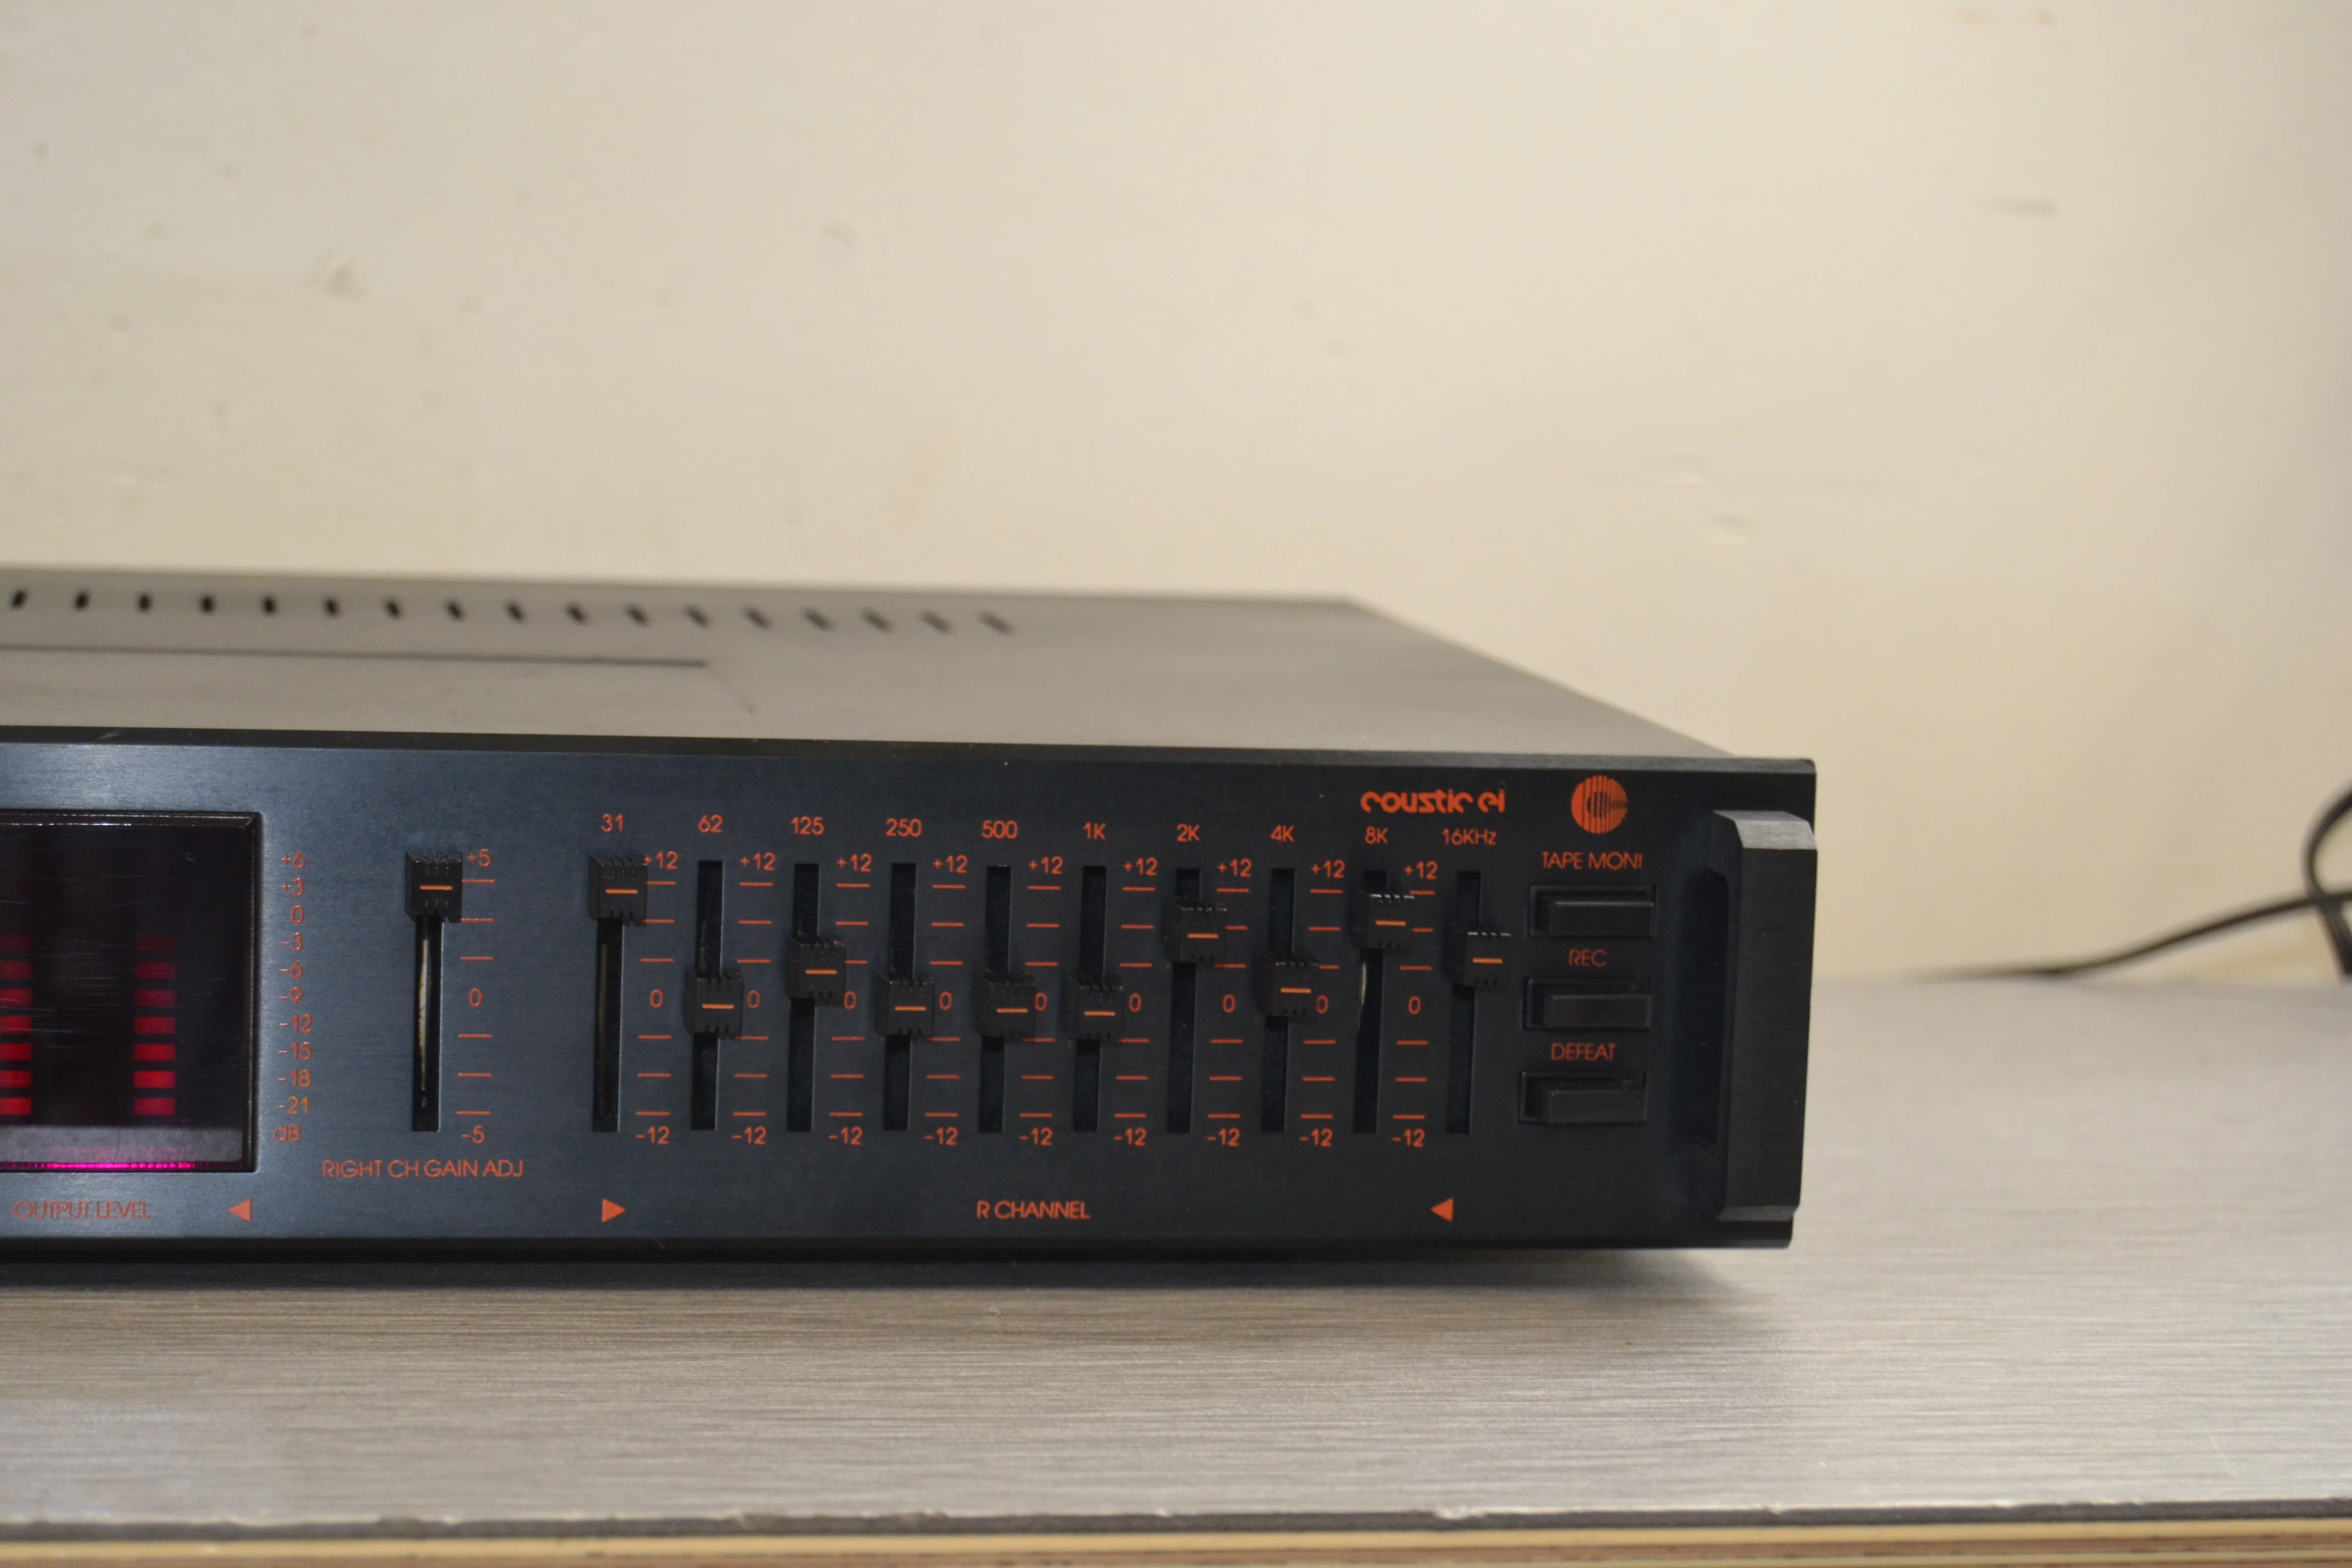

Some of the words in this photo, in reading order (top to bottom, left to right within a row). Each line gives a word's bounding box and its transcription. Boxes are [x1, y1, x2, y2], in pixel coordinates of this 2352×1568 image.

[601, 814, 624, 833] 31
[698, 814, 723, 834] 62
[791, 816, 825, 836] 125
[886, 818, 922, 837] 250
[982, 820, 1018, 839] 500
[1085, 822, 1106, 840] 1K
[1177, 824, 1199, 842] 2K
[1270, 825, 1294, 842] 4K
[1365, 826, 1388, 845] 8K
[1442, 828, 1497, 846] 16KHz
[283, 851, 306, 870] +6
[469, 848, 492, 868] +5
[644, 850, 679, 870] +12
[741, 852, 776, 871] +12
[838, 853, 873, 873] +12
[934, 854, 968, 874] +12
[1029, 855, 1064, 875] +12
[1123, 856, 1158, 876] +12
[1542, 851, 1582, 870] TAPE
[1218, 858, 1253, 878] +12
[1311, 859, 1346, 879] +12
[1404, 860, 1438, 880] +12
[282, 878, 305, 897] +3
[290, 905, 305, 924] 0
[280, 933, 304, 951] -3
[1569, 948, 1606, 967] REC
[280, 961, 304, 978] -6
[280, 987, 304, 1005] -9
[469, 988, 483, 1007] 0
[650, 989, 664, 1009] 0
[747, 990, 761, 1009] 0
[843, 991, 857, 1010] 0
[939, 992, 952, 1010] 0
[1034, 992, 1047, 1011] 0
[1129, 993, 1142, 1012] 0
[1222, 994, 1236, 1013] 0
[1316, 995, 1329, 1014] 0
[1408, 996, 1422, 1015] 0
[279, 1014, 313, 1034] -12
[279, 1042, 313, 1061] -15
[1551, 1042, 1615, 1061] DEFEAT
[279, 1069, 312, 1088] -18
[277, 1096, 309, 1115] -21
[274, 1124, 301, 1142] dB
[462, 1125, 486, 1144] -5
[636, 1125, 670, 1145] -12
[733, 1125, 767, 1145] -12
[829, 1126, 864, 1146] -12
[925, 1126, 959, 1146] -12
[1020, 1126, 1054, 1146] -12
[1114, 1127, 1147, 1147] -12
[1208, 1128, 1241, 1147] -12
[1300, 1128, 1333, 1147] -12
[1392, 1128, 1426, 1148] -12
[323, 1160, 383, 1179] RIGHT
[387, 1160, 420, 1179] CH
[424, 1160, 479, 1178] GAIN
[482, 1159, 524, 1178] ADJ
[13, 1200, 90, 1219] OUTPUT
[95, 1200, 149, 1219] LEVEL
[977, 1200, 990, 1218] R
[994, 1200, 1090, 1219] CHANNEL
